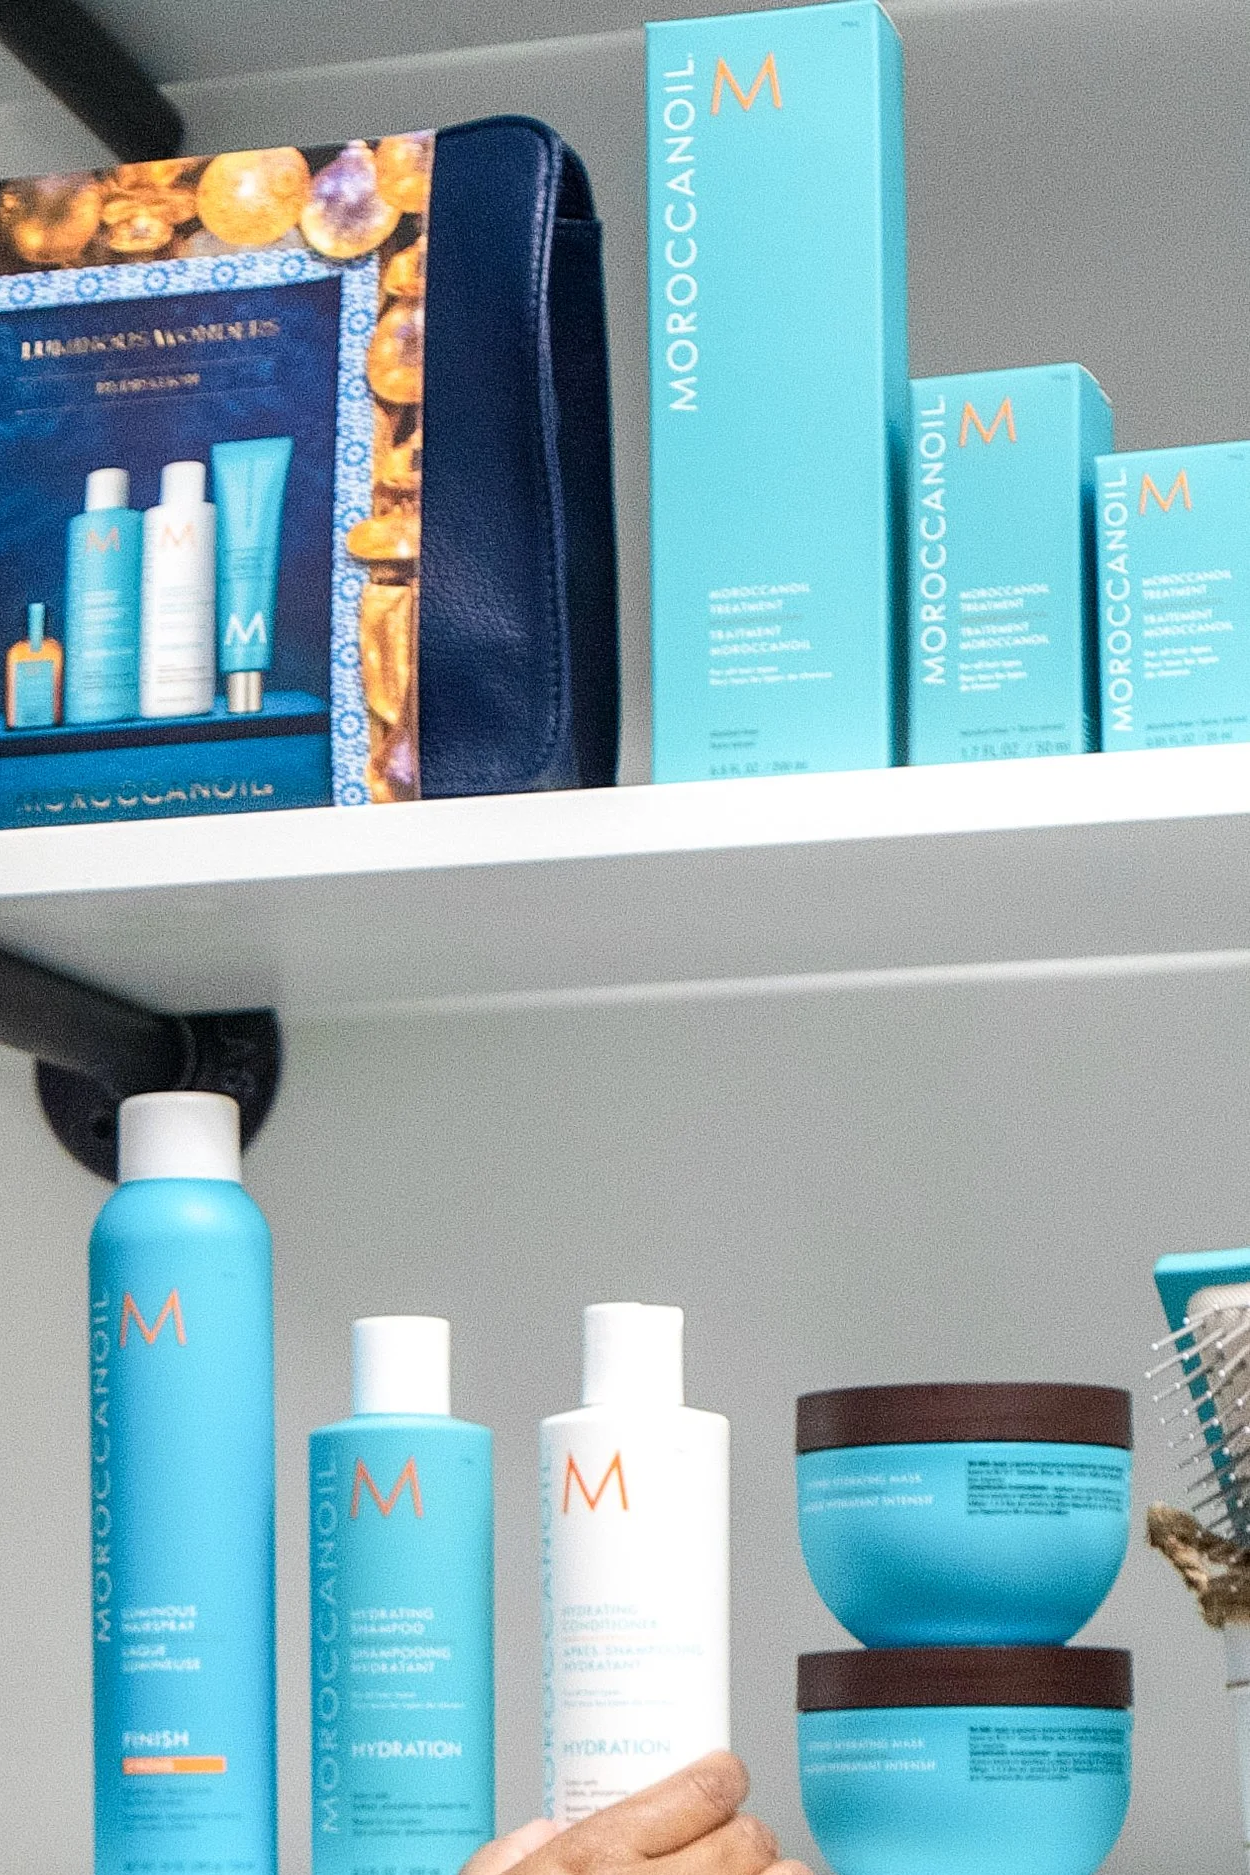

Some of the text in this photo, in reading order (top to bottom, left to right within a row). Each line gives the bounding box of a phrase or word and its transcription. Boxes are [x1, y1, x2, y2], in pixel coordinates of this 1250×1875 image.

[710, 52, 782, 116] M
[663, 53, 699, 411] MOROCCANOIL
[958, 396, 1017, 447] M
[1140, 468, 1193, 516] M
[920, 394, 947, 685] MOROCCANOIL
[224, 611, 267, 646] M
[1104, 468, 1133, 732] MOROCCANOIL
[120, 1288, 188, 1347] M
[94, 1287, 113, 1643] MOROCCANOIL
[351, 1455, 425, 1518] M
[563, 1450, 628, 1516] M
[317, 1465, 340, 1834] MOROCCANOIL
[123, 1730, 190, 1748] FINISH
[351, 1740, 463, 1759] HYDRATION
[562, 1739, 672, 1757] HYDRATION
